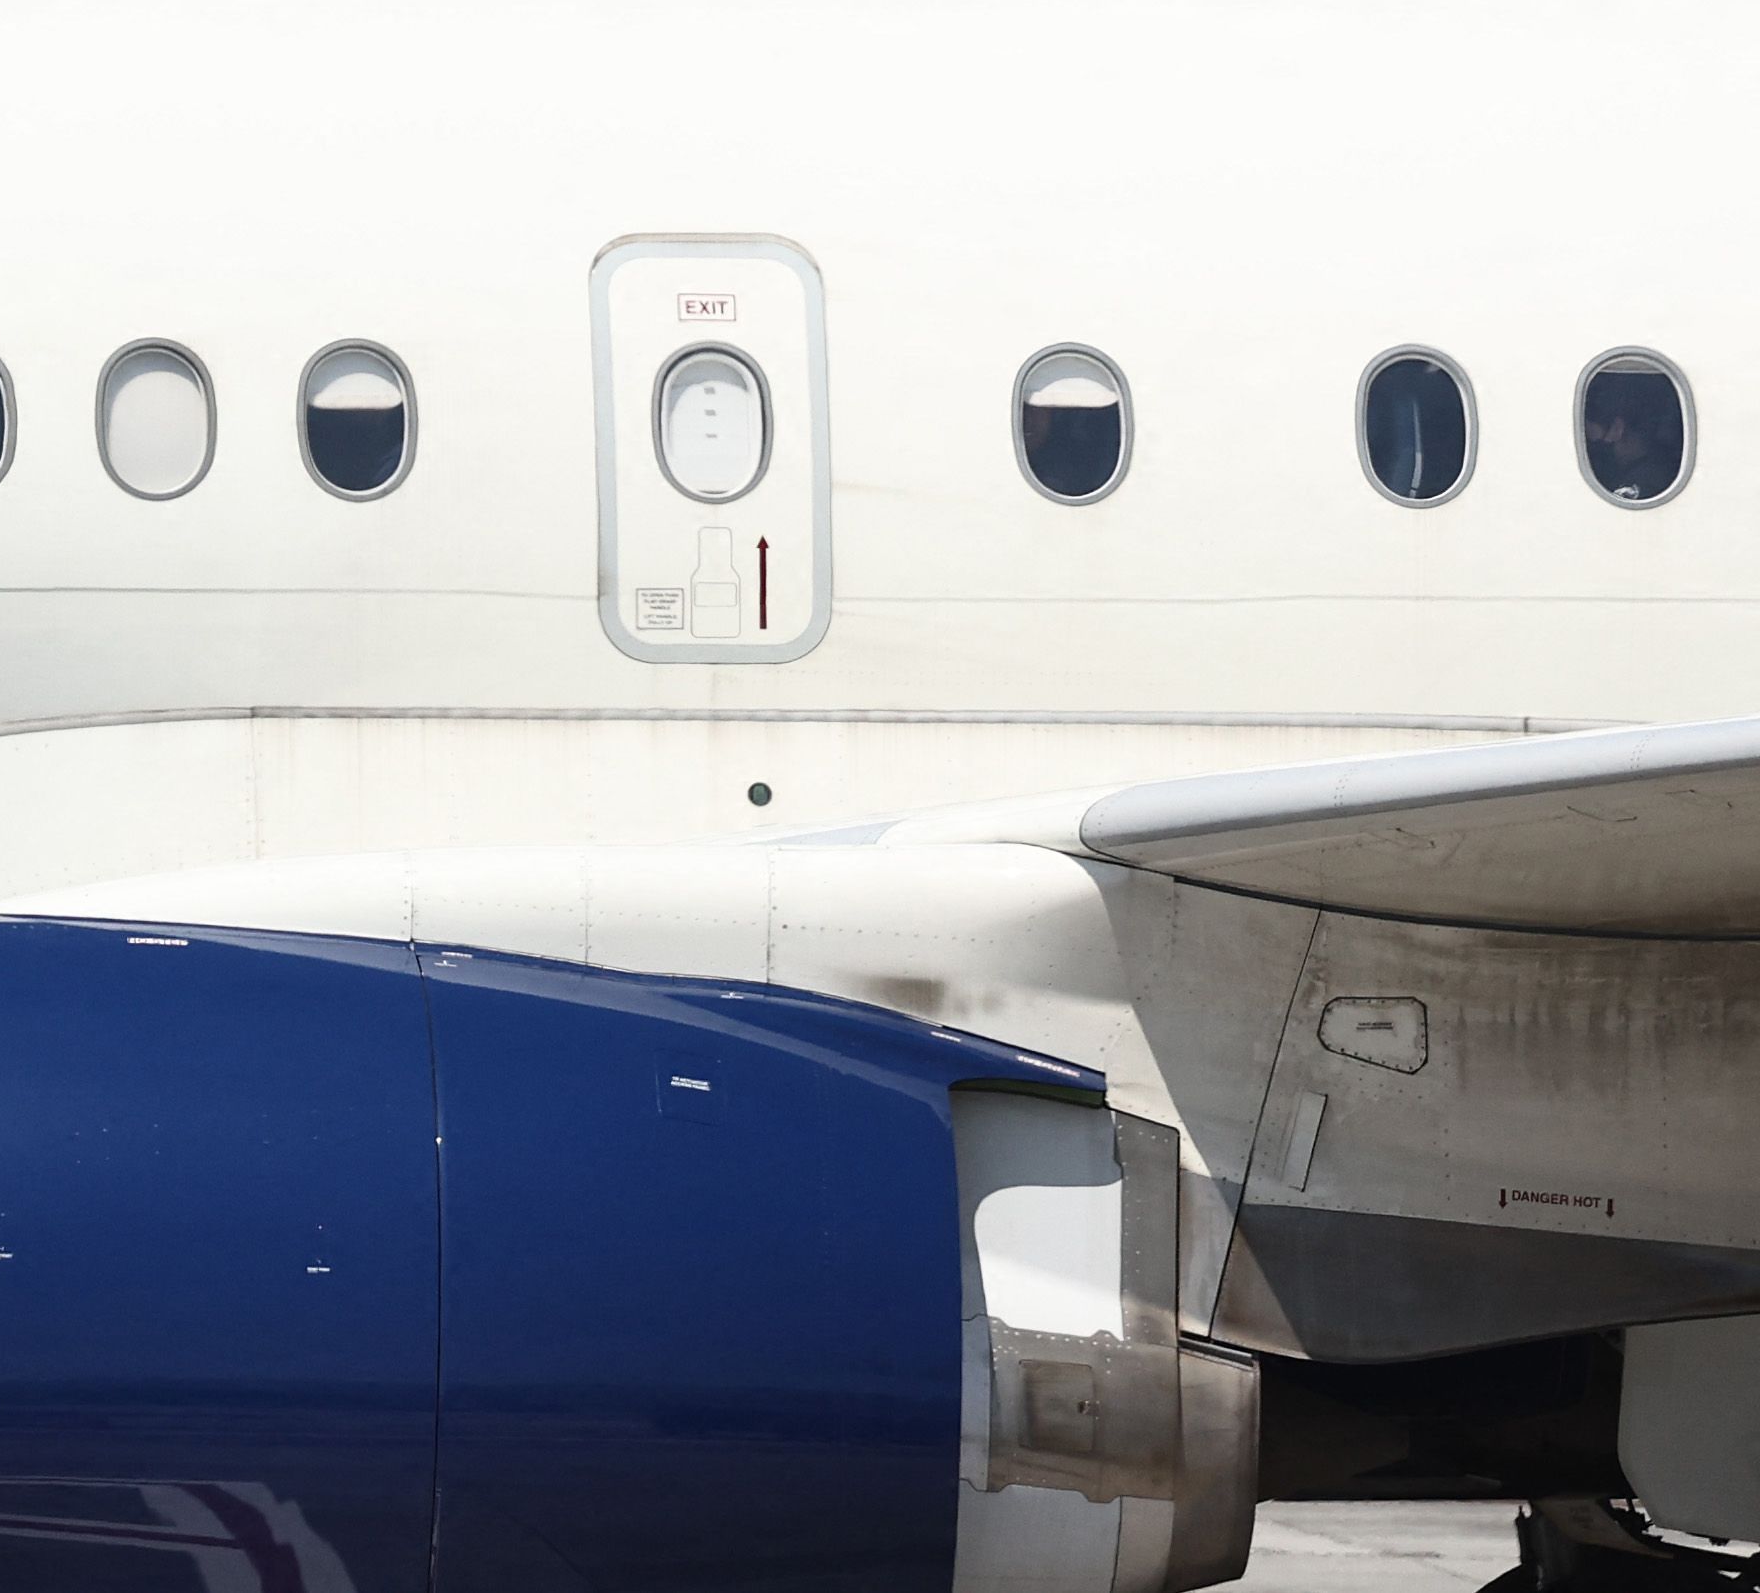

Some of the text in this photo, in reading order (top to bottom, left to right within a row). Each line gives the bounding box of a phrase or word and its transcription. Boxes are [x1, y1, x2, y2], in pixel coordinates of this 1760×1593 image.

[685, 300, 729, 314] EXIT
[1511, 1190, 1602, 1208] DANGER HOT
